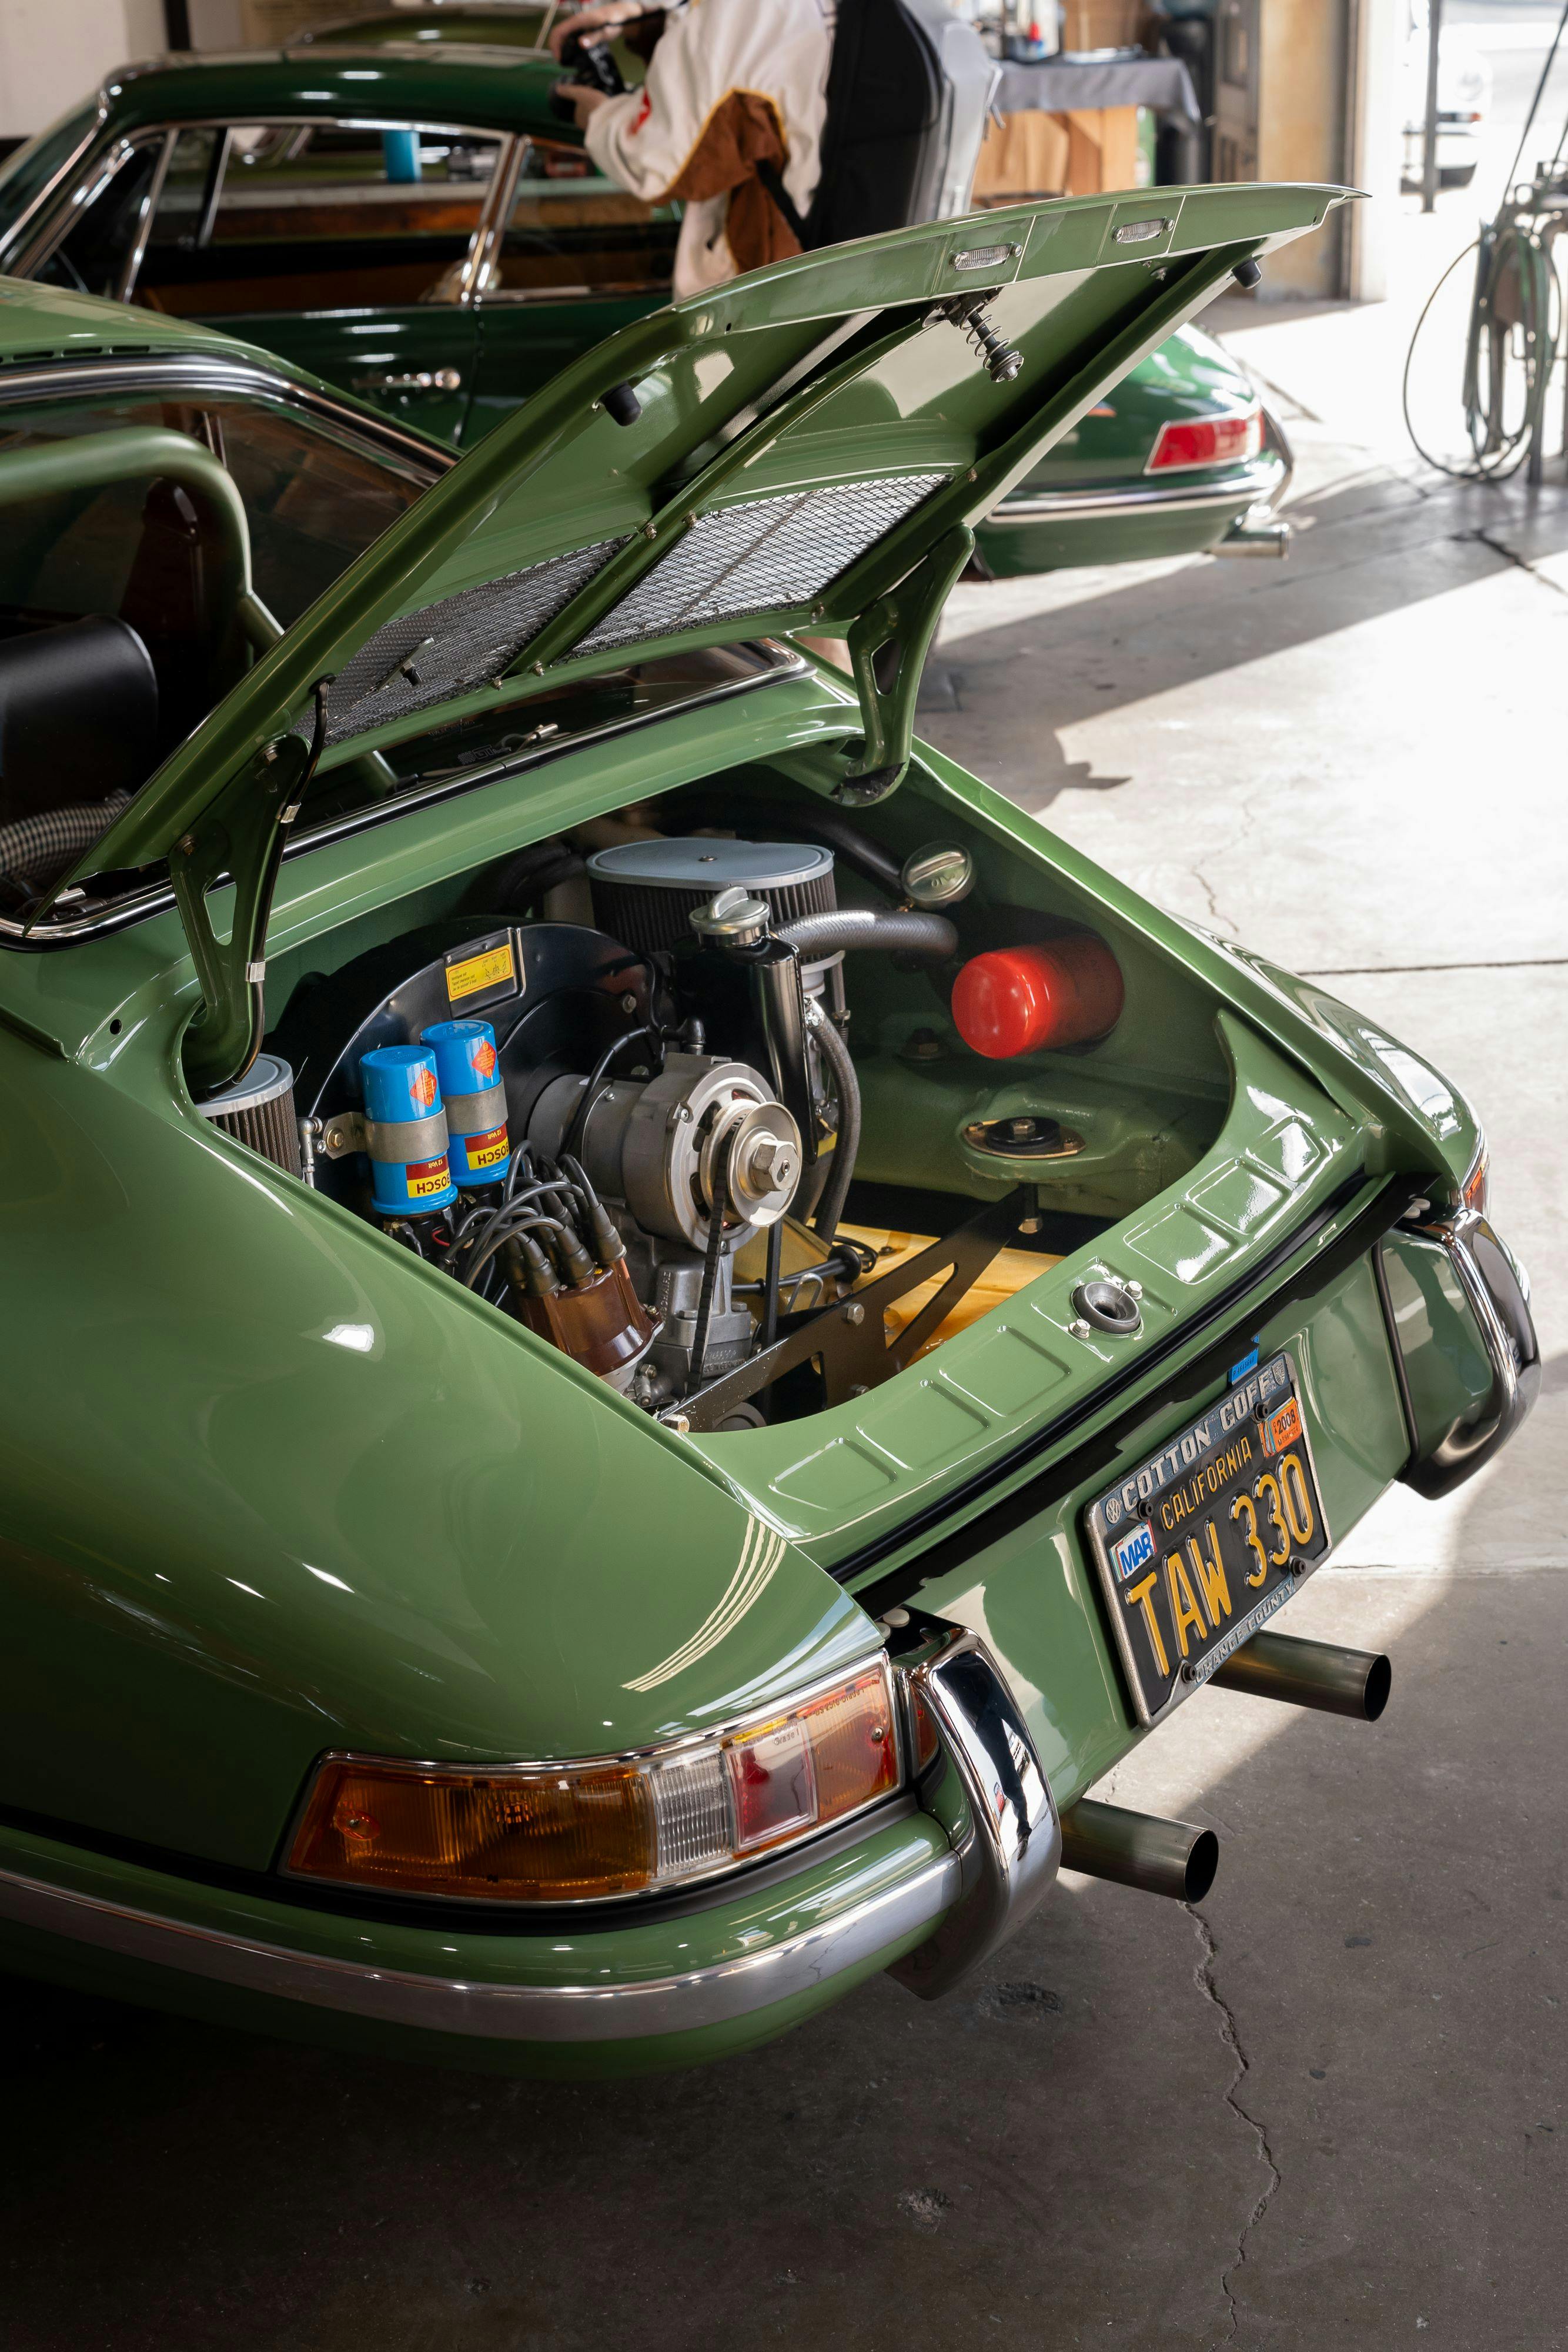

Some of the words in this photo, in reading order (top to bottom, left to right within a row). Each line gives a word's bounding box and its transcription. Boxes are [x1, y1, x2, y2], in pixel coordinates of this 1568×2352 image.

[477, 1141, 509, 1165] BOSCH
[487, 1132, 497, 1140] Volt
[416, 1172, 450, 1194] BOSCH
[1121, 1421, 1212, 1512] COTTON
[1219, 1370, 1271, 1432] GOFF
[1276, 1408, 1296, 1435] 2008
[1161, 1436, 1252, 1531] CALIFORNIA
[1119, 1531, 1154, 1576] MAR
[1127, 1521, 1232, 1677] TAW
[1232, 1454, 1314, 1587] 330
[1195, 1629, 1246, 1683] ORANGE
[1246, 1580, 1294, 1633] COUNTY
